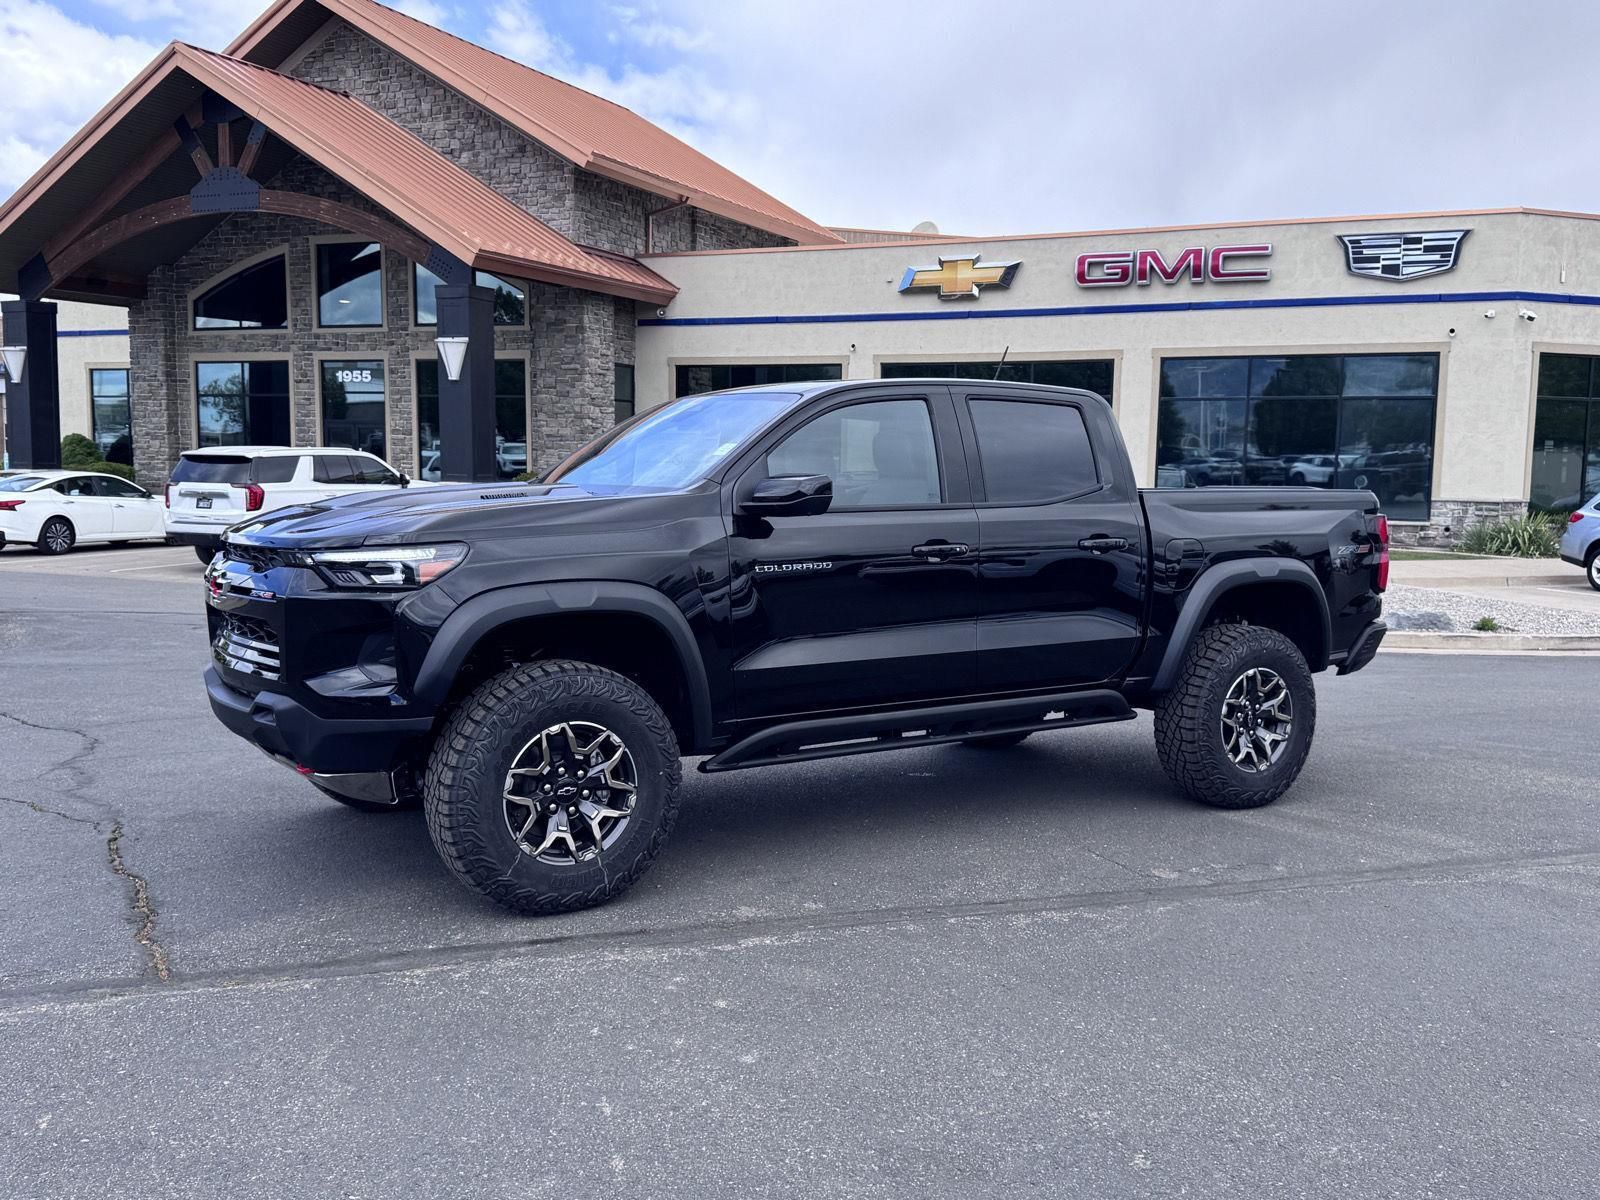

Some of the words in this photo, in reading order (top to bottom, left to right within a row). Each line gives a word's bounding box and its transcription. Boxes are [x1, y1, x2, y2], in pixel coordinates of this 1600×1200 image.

[1074, 243, 1272, 288] GMC
[336, 370, 372, 382] 1955
[754, 561, 833, 573] COLORADO
